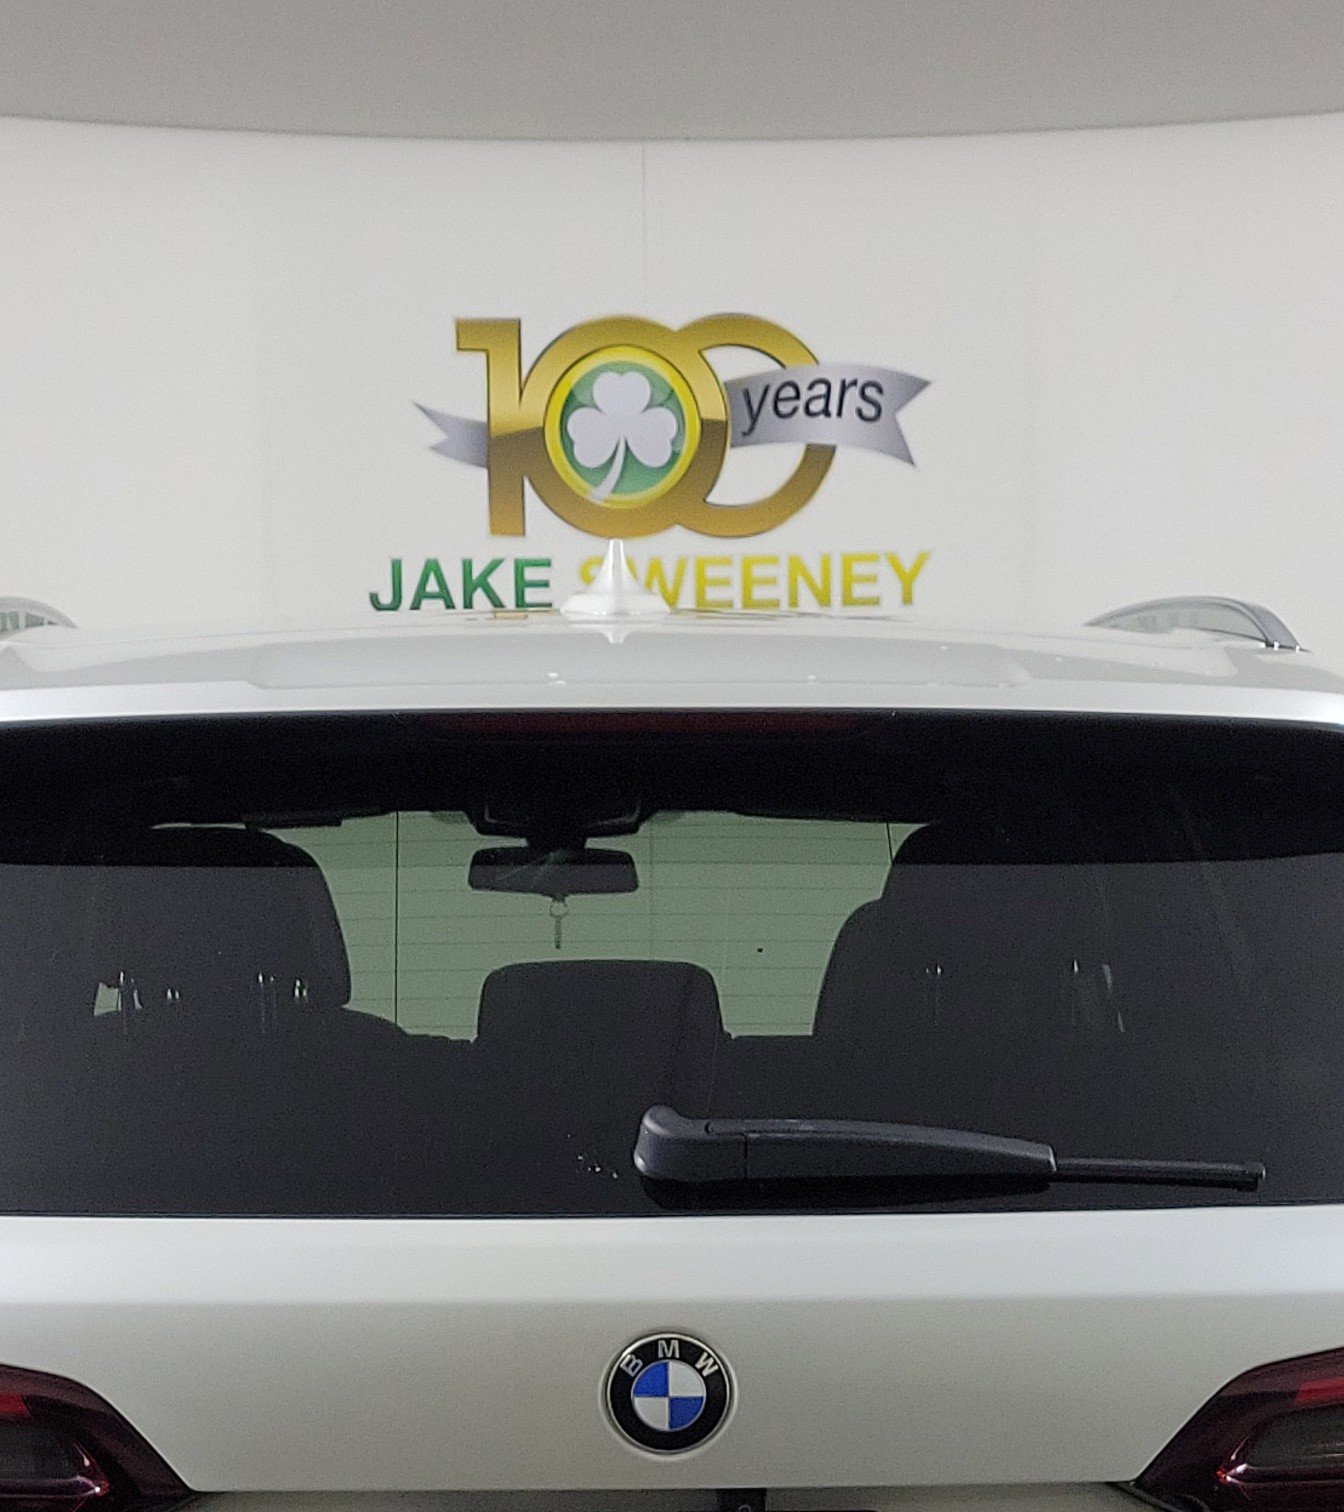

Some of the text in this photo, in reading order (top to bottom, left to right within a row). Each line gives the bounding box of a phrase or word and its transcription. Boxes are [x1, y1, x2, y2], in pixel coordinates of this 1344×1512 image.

[741, 376, 885, 436] years
[369, 557, 553, 612] JAKE
[619, 1339, 719, 1377] BMW
